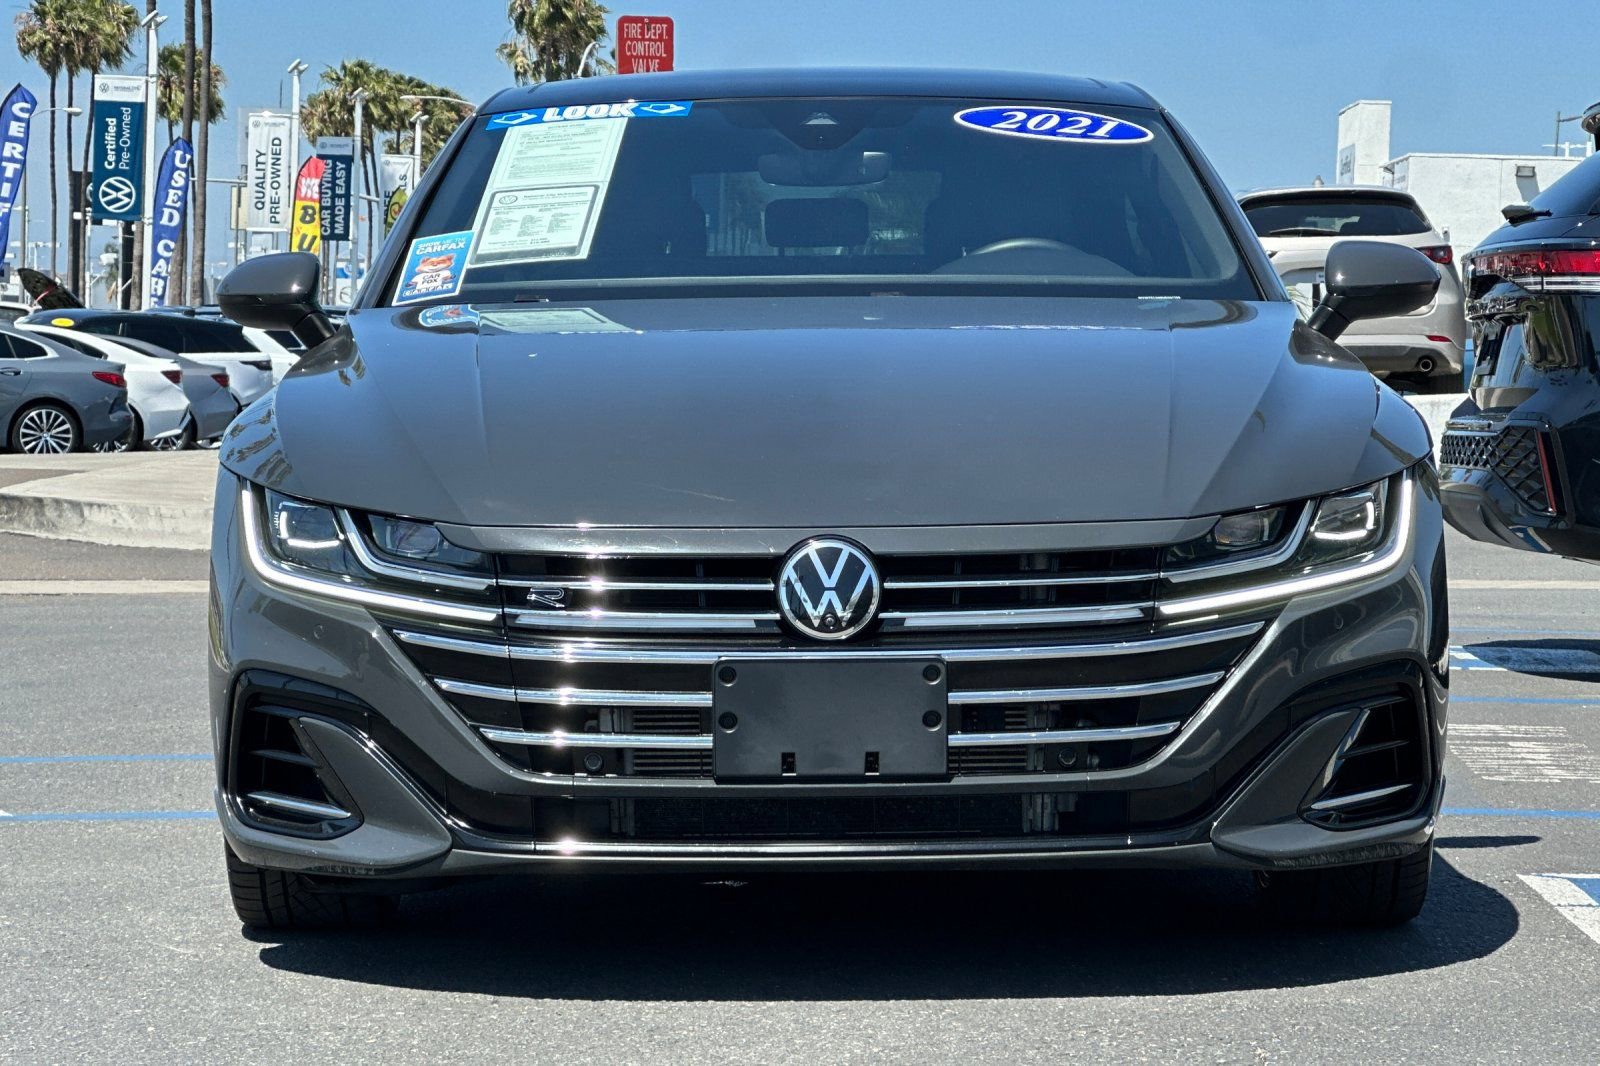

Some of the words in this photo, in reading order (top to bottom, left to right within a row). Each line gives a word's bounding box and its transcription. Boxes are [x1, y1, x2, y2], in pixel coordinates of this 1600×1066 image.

[624, 23, 642, 38] FIRE
[625, 40, 667, 57] CONTROL
[542, 103, 639, 122] LOOK
[991, 111, 1119, 137] 2021
[104, 117, 117, 169] Certified
[119, 107, 131, 170] Pre-Owned
[159, 150, 191, 227] USED
[254, 149, 267, 211] QUALITY
[269, 137, 282, 225] PRE-OWNED
[321, 160, 333, 207] BUYING
[335, 161, 346, 196] EASY
[321, 208, 331, 236] CAR
[334, 201, 345, 234] MADE
[416, 241, 466, 255] CARFAX
[421, 278, 438, 286] FOX
[422, 273, 441, 281] CAR
